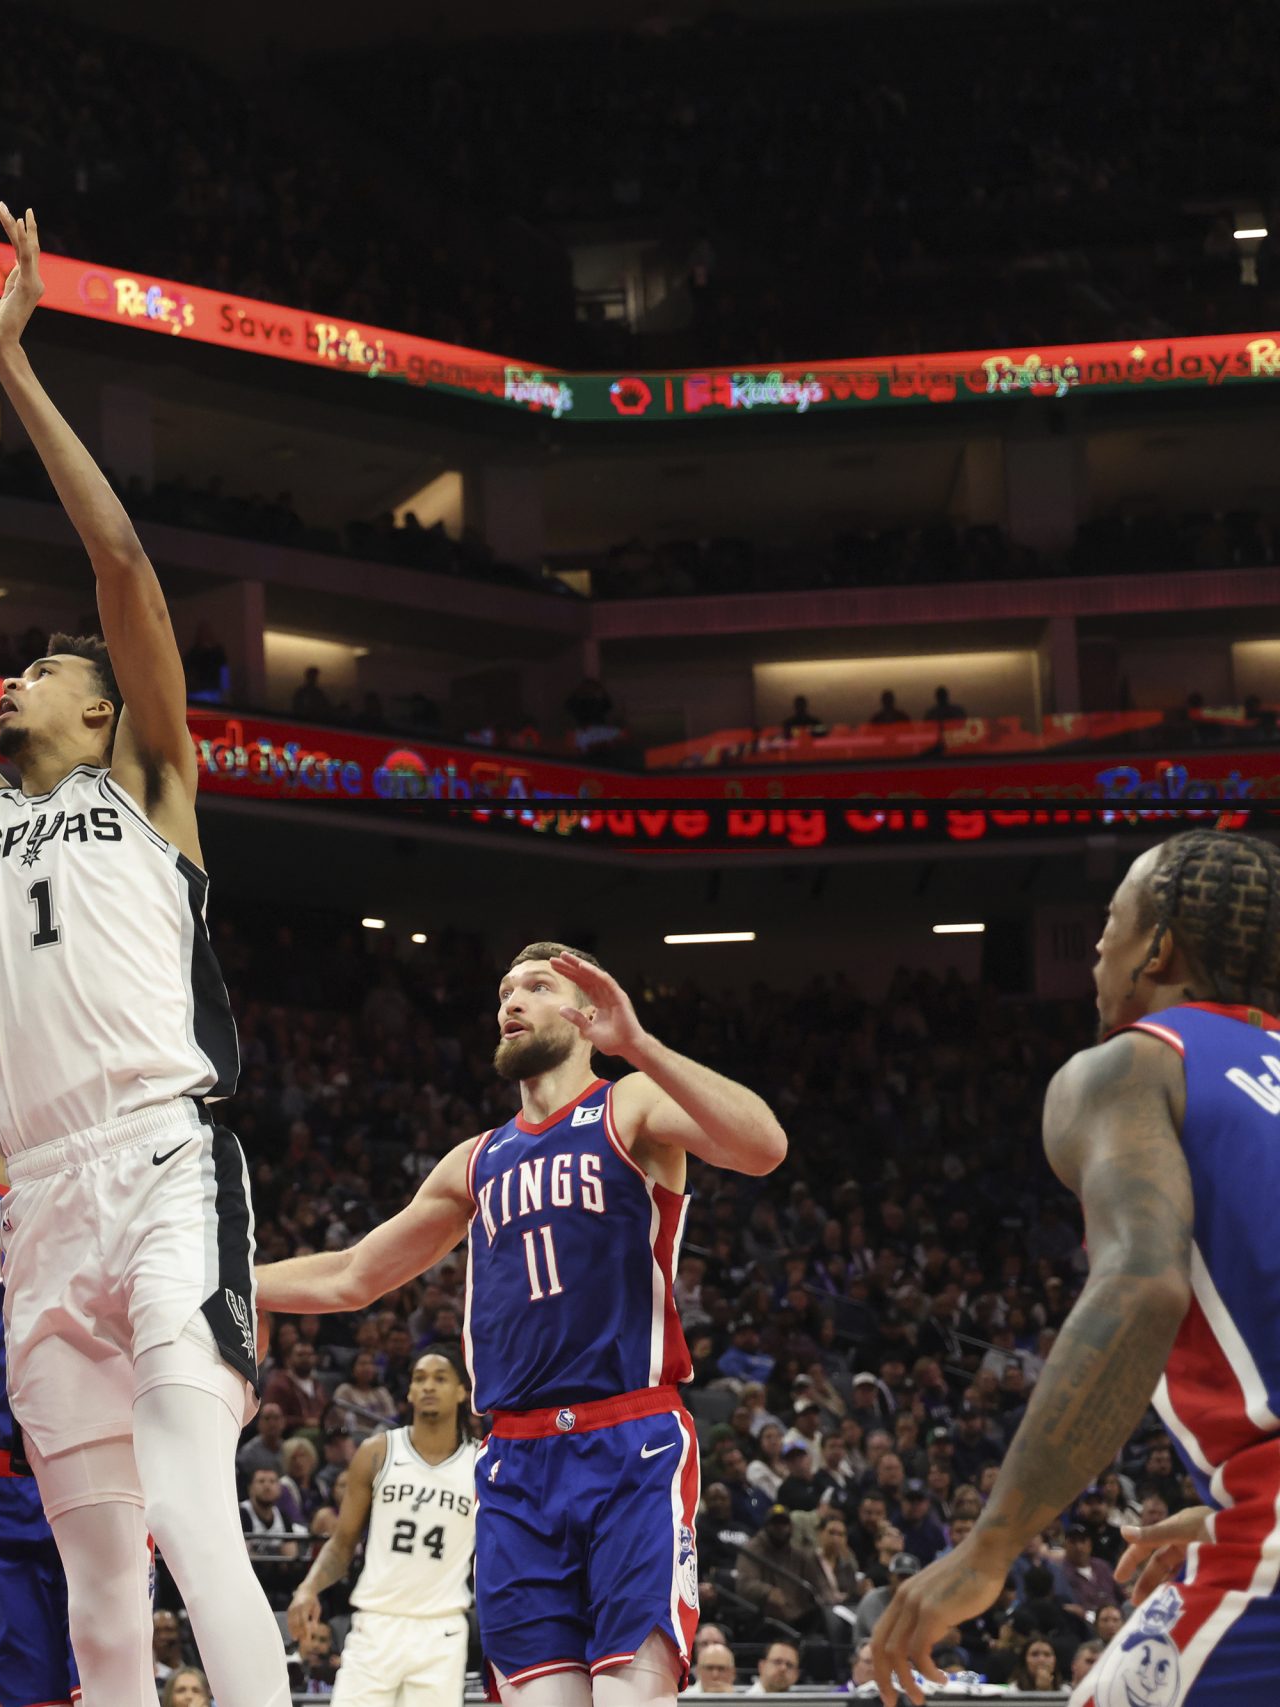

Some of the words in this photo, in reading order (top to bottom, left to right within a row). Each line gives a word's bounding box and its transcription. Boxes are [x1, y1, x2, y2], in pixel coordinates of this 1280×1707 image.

[219, 304, 293, 347] Save
[27, 876, 62, 951] 1
[478, 1153, 606, 1249] KINGS
[523, 1224, 564, 1302] 11
[382, 1484, 471, 1517] SPURS
[391, 1518, 446, 1561] 24
